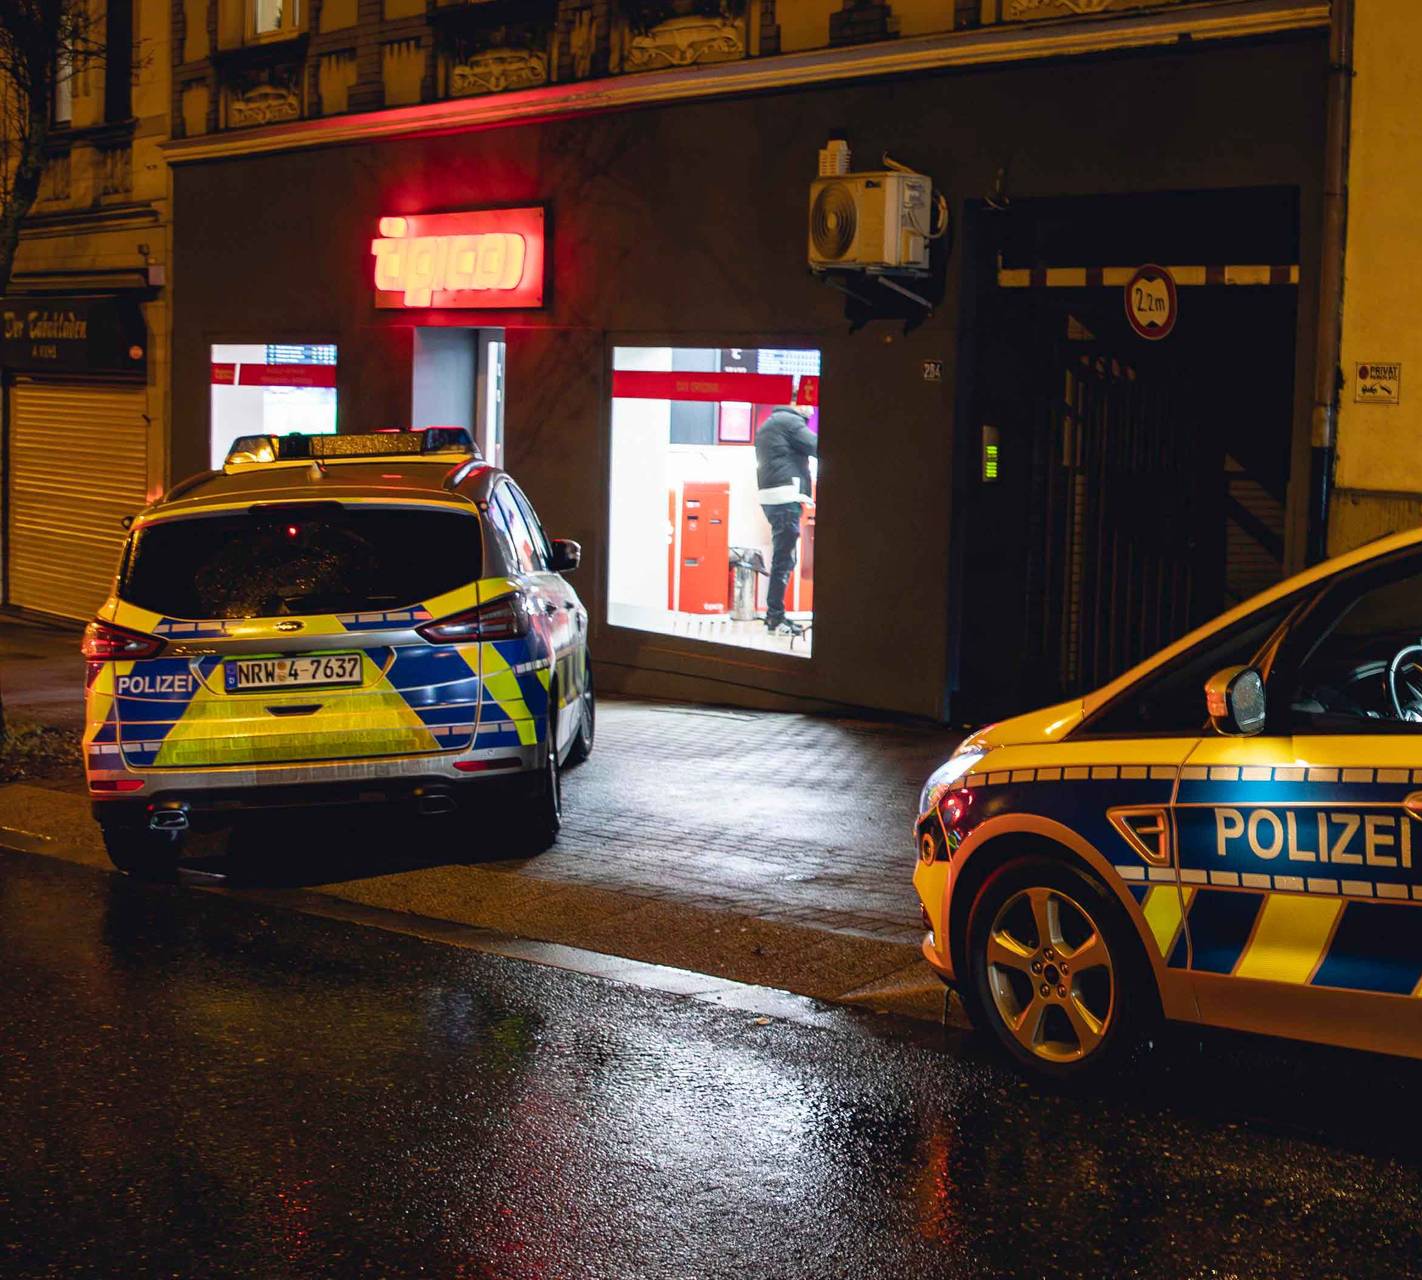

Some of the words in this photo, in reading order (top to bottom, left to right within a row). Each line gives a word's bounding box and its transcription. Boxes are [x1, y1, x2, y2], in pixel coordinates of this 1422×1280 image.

[372, 217, 526, 307] tipico
[3, 311, 24, 338] Der
[1370, 366, 1398, 376] PRIVAT
[118, 675, 193, 694] POLIZEI
[238, 662, 278, 685] NRW
[288, 657, 359, 683] 4-7637
[1214, 807, 1412, 868] POLIZEI
